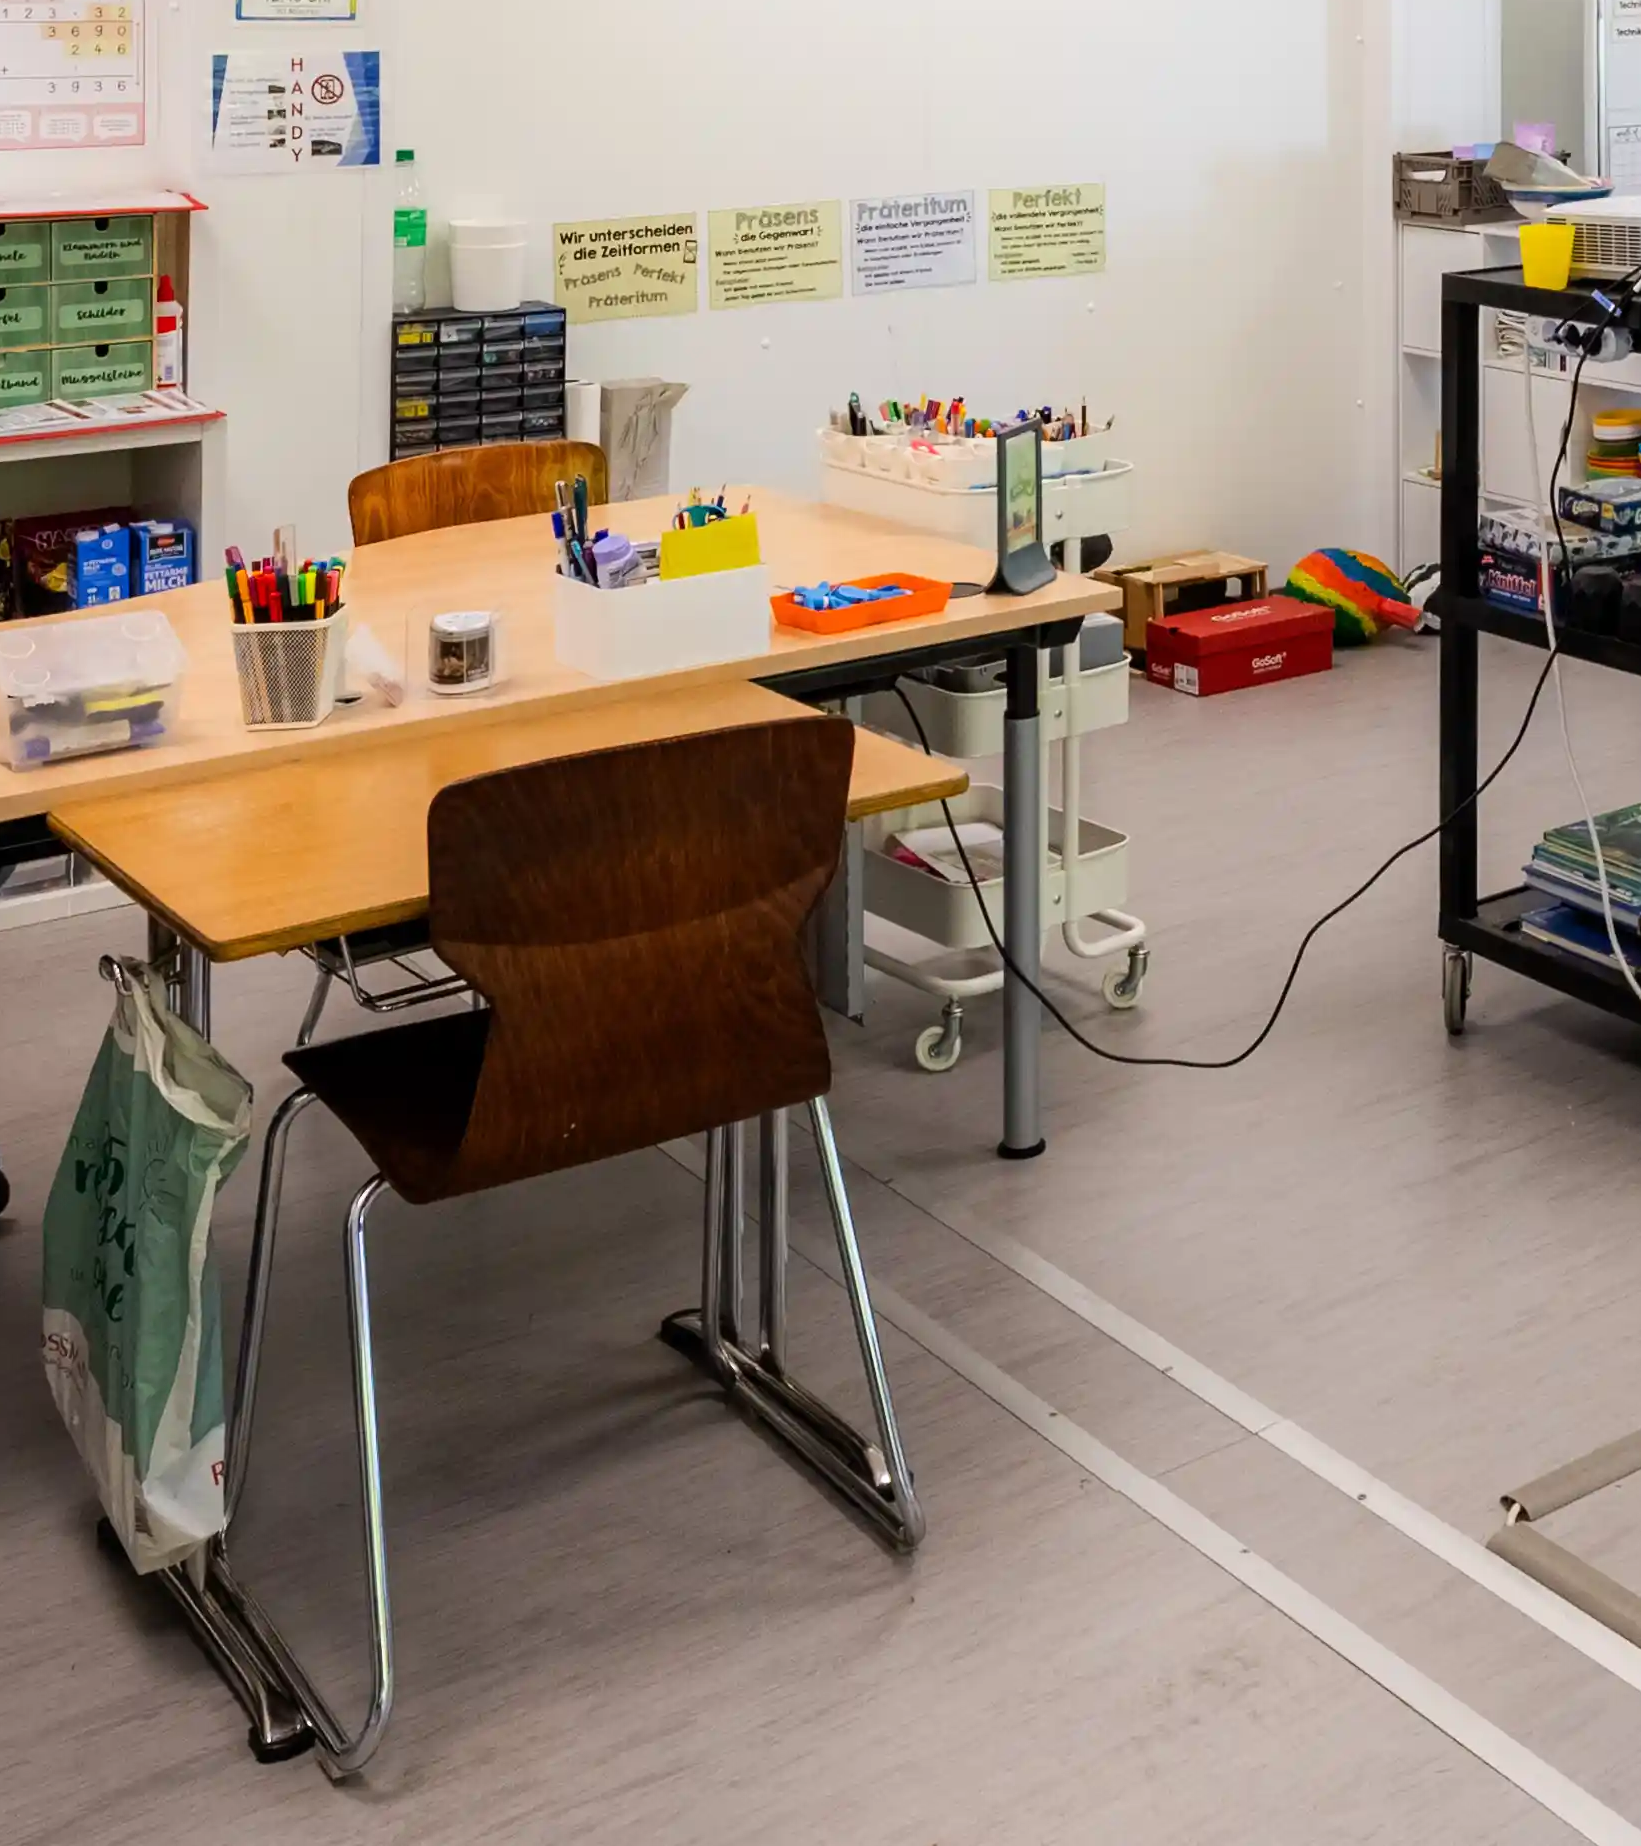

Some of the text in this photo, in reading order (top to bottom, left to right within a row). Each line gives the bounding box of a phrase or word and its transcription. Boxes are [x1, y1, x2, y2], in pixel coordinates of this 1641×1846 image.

[1617, 28, 1641, 36] Technik
[1013, 188, 1081, 208] Perfekt
[858, 197, 967, 221] Präteritum
[1048, 207, 1099, 220] Vergangenheit
[735, 209, 818, 231] Präsens
[860, 216, 965, 232] die einfache Vergangenheit
[559, 224, 692, 245] Wir unterscheiden
[741, 227, 813, 242] die Gegenwart
[120, 238, 142, 249] und
[573, 242, 680, 260] die Zeitformen
[564, 263, 685, 290] Präsens Perfekt
[589, 291, 668, 308] Präteritum
[77, 307, 126, 320] Schilder
[61, 369, 144, 385] Muggelsteine
[144, 567, 188, 580] FETTARME
[144, 577, 187, 592] MILCH
[1487, 570, 1537, 597] Kniffel
